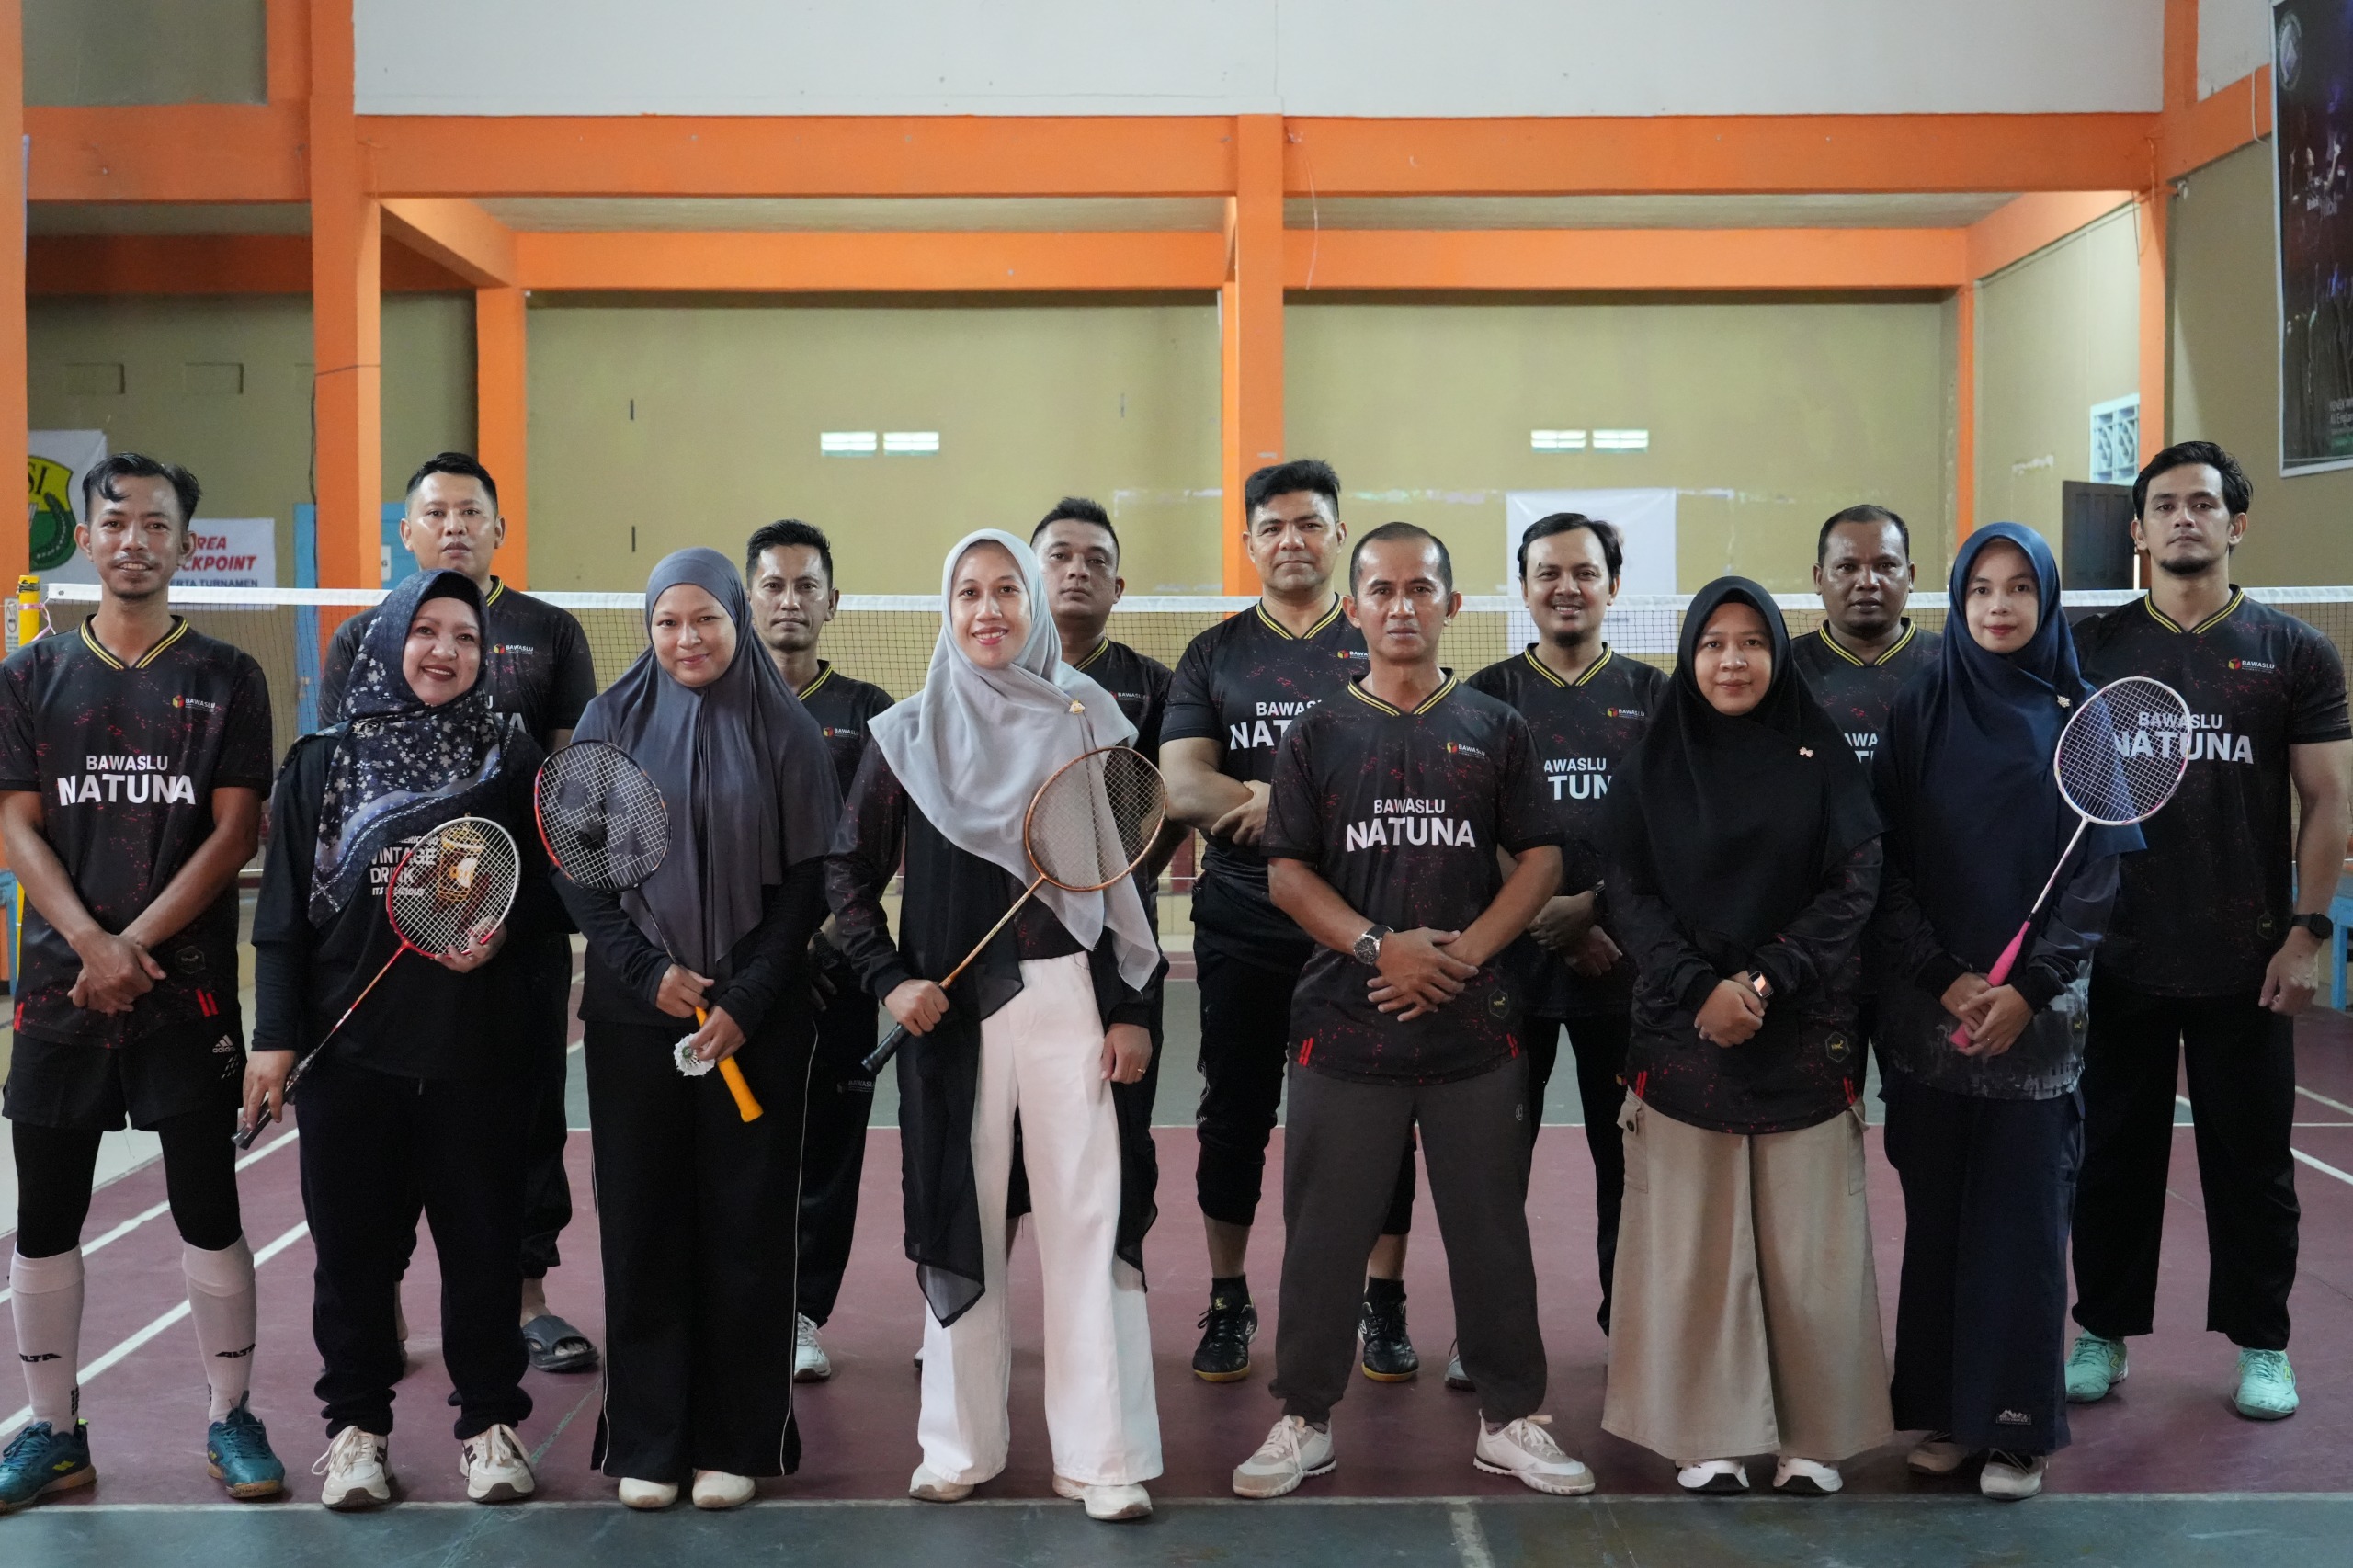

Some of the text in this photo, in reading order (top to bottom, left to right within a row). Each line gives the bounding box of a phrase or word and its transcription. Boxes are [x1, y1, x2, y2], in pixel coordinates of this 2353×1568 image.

[197, 535, 227, 550] REA
[182, 554, 257, 571] KPOINT
[200, 579, 258, 587] TURNAMEN
[2242, 660, 2275, 669] BAWASLU
[186, 698, 216, 709] BAWASLU
[1618, 708, 1645, 717] BAWASLU
[2138, 711, 2222, 730] BAWASLU
[1229, 719, 1293, 751] NAT
[1458, 744, 1486, 756] BAWASLU
[2113, 729, 2255, 765] NATUNA
[85, 755, 169, 771] BAWASLU
[1544, 757, 1607, 773] AWASLU
[57, 773, 197, 807] NATUNA
[1547, 773, 1613, 801] TUN
[1373, 797, 1446, 814] BAWASLU
[1346, 816, 1476, 853] NATUNA
